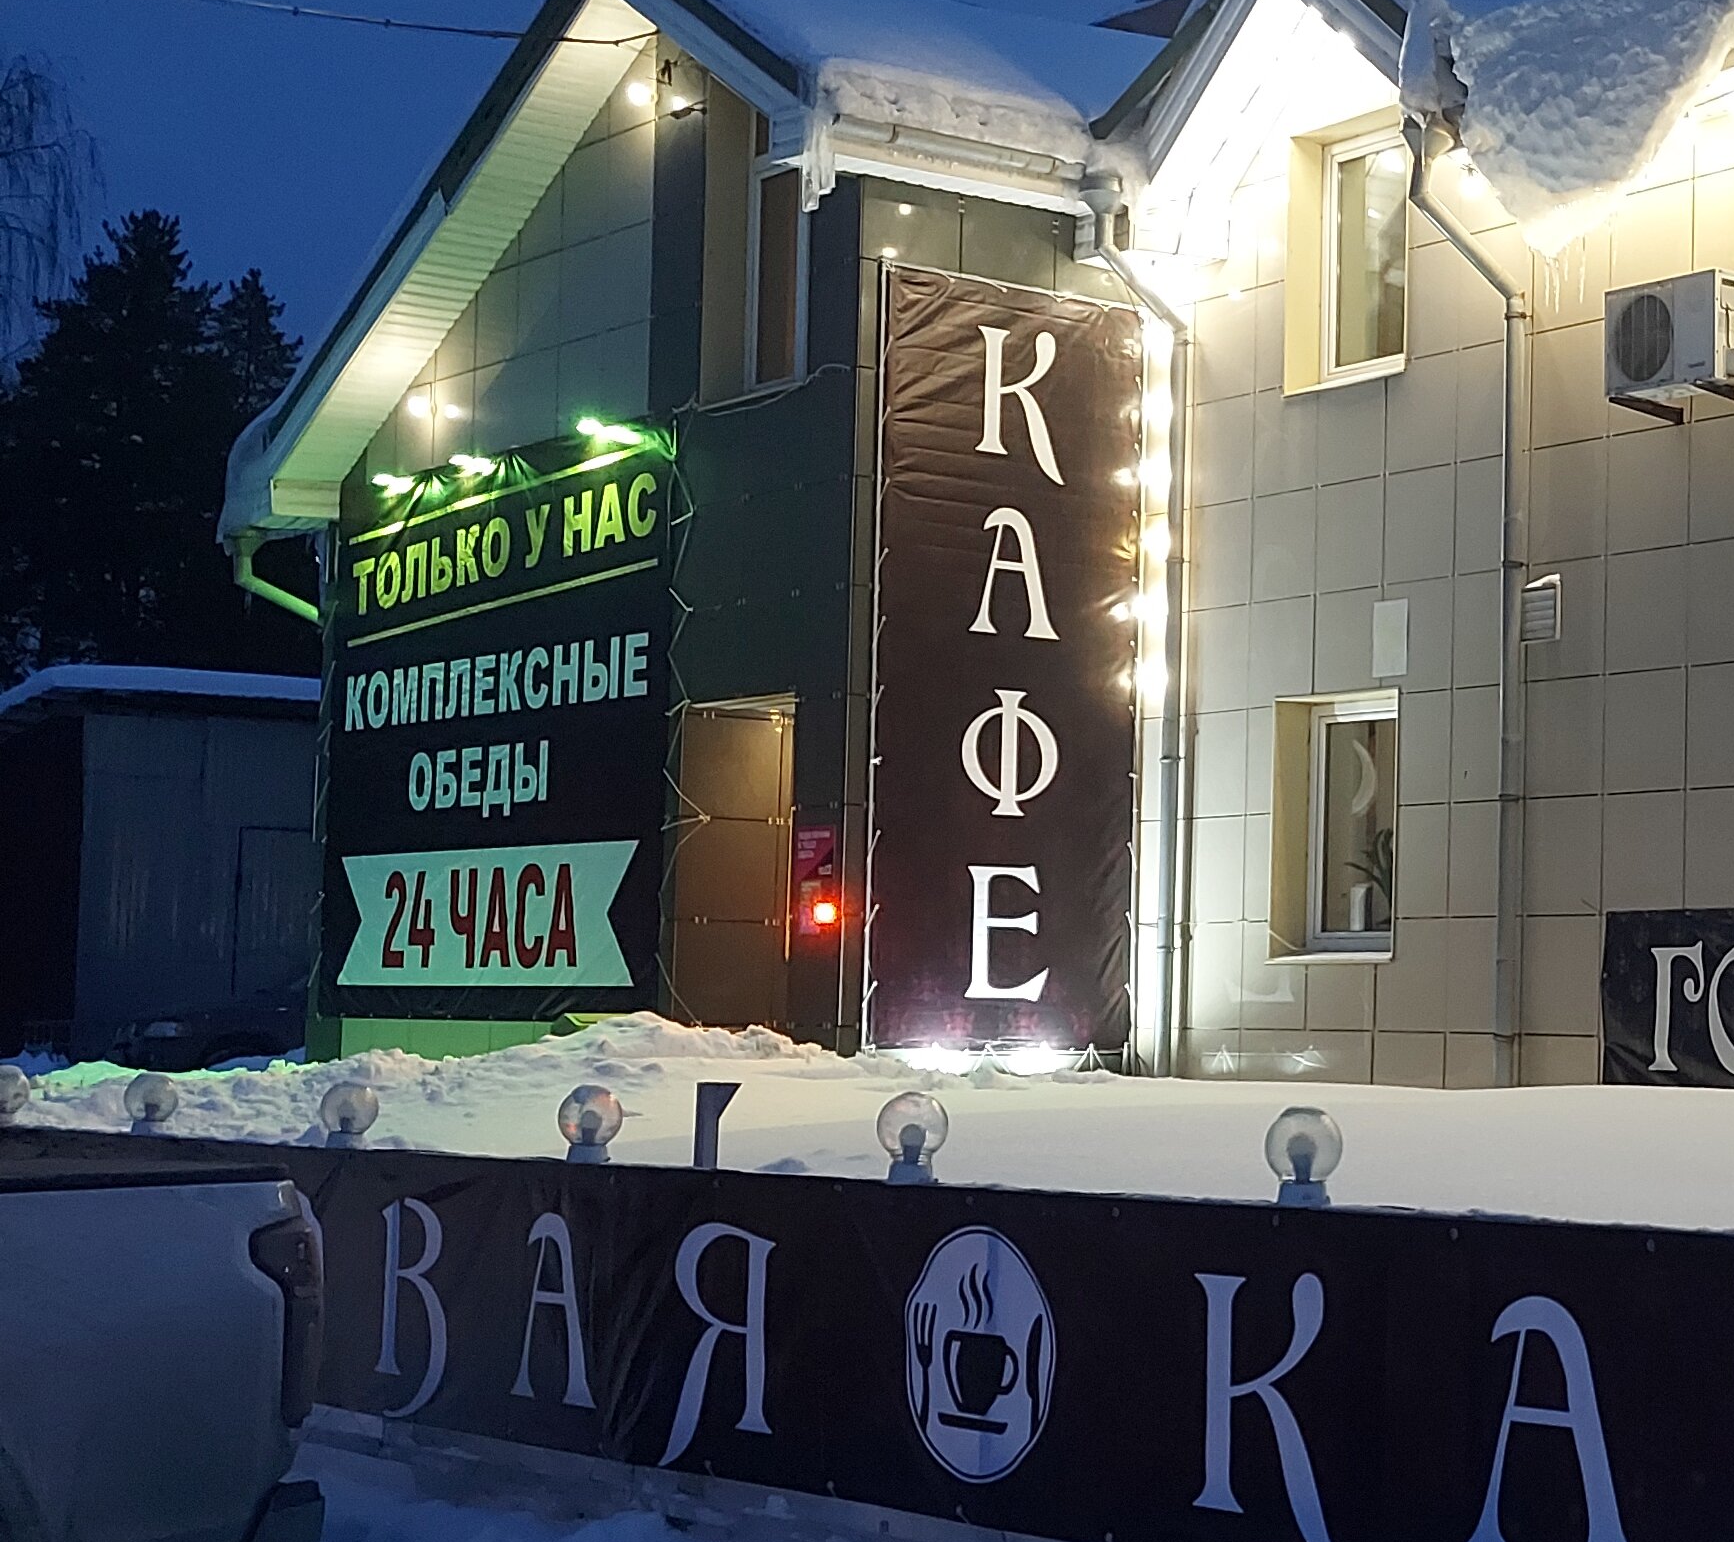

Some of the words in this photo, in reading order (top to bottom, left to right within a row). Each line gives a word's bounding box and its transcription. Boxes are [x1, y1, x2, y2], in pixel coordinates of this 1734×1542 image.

[353, 517, 511, 616] ТОЛЬКО
[525, 504, 551, 569] У
[563, 472, 657, 558] НАС
[345, 632, 650, 732] КОМПЛЕКСНЫЕ
[961, 323, 1066, 1002] КАФЕ
[408, 740, 549, 818] ОБЕДЫ
[381, 870, 435, 969] 24
[450, 863, 577, 969] ЧАСА
[296, 1190, 777, 1466] ВАЯ
